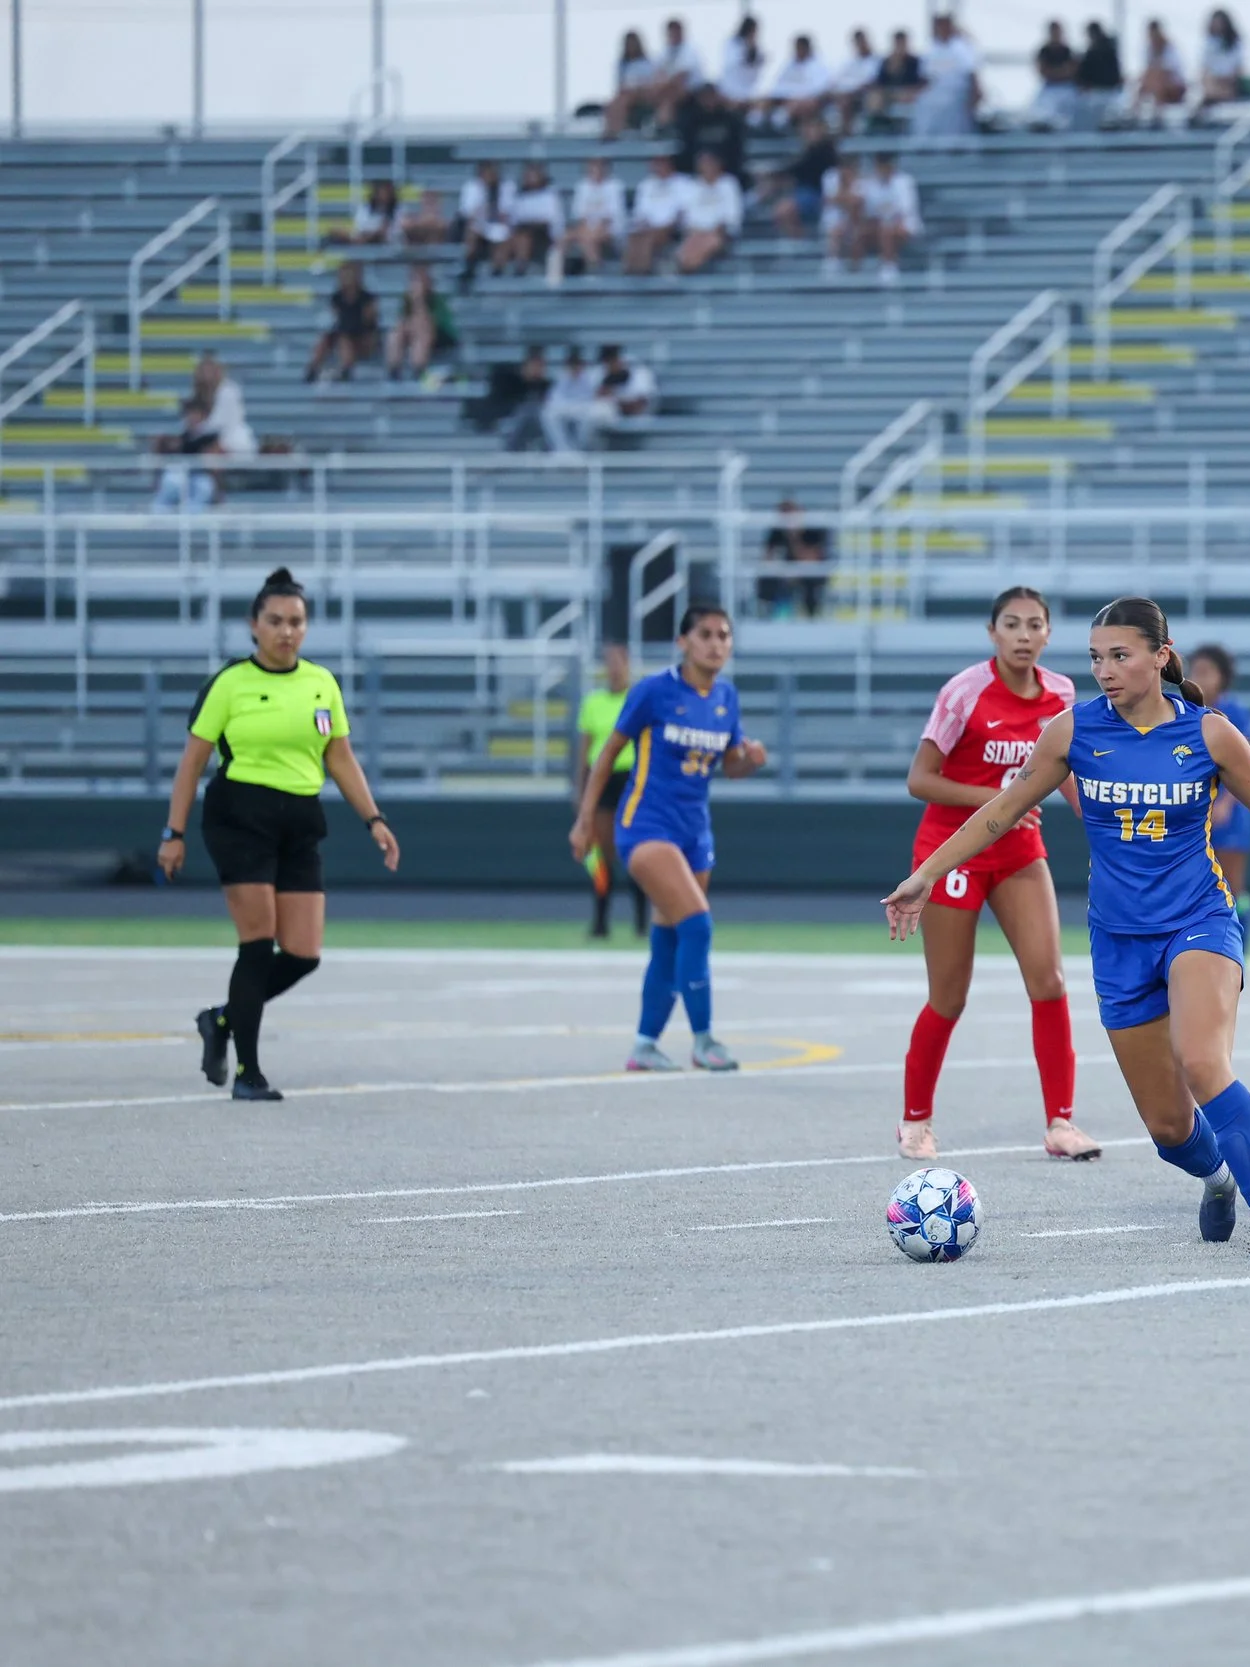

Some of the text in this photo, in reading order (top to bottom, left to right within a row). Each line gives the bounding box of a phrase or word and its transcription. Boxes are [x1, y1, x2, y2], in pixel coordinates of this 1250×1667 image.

[983, 740, 1035, 764] SIMPS
[1079, 777, 1204, 805] WESTCLIFF
[1114, 808, 1168, 842] 14
[945, 868, 968, 898] 6
